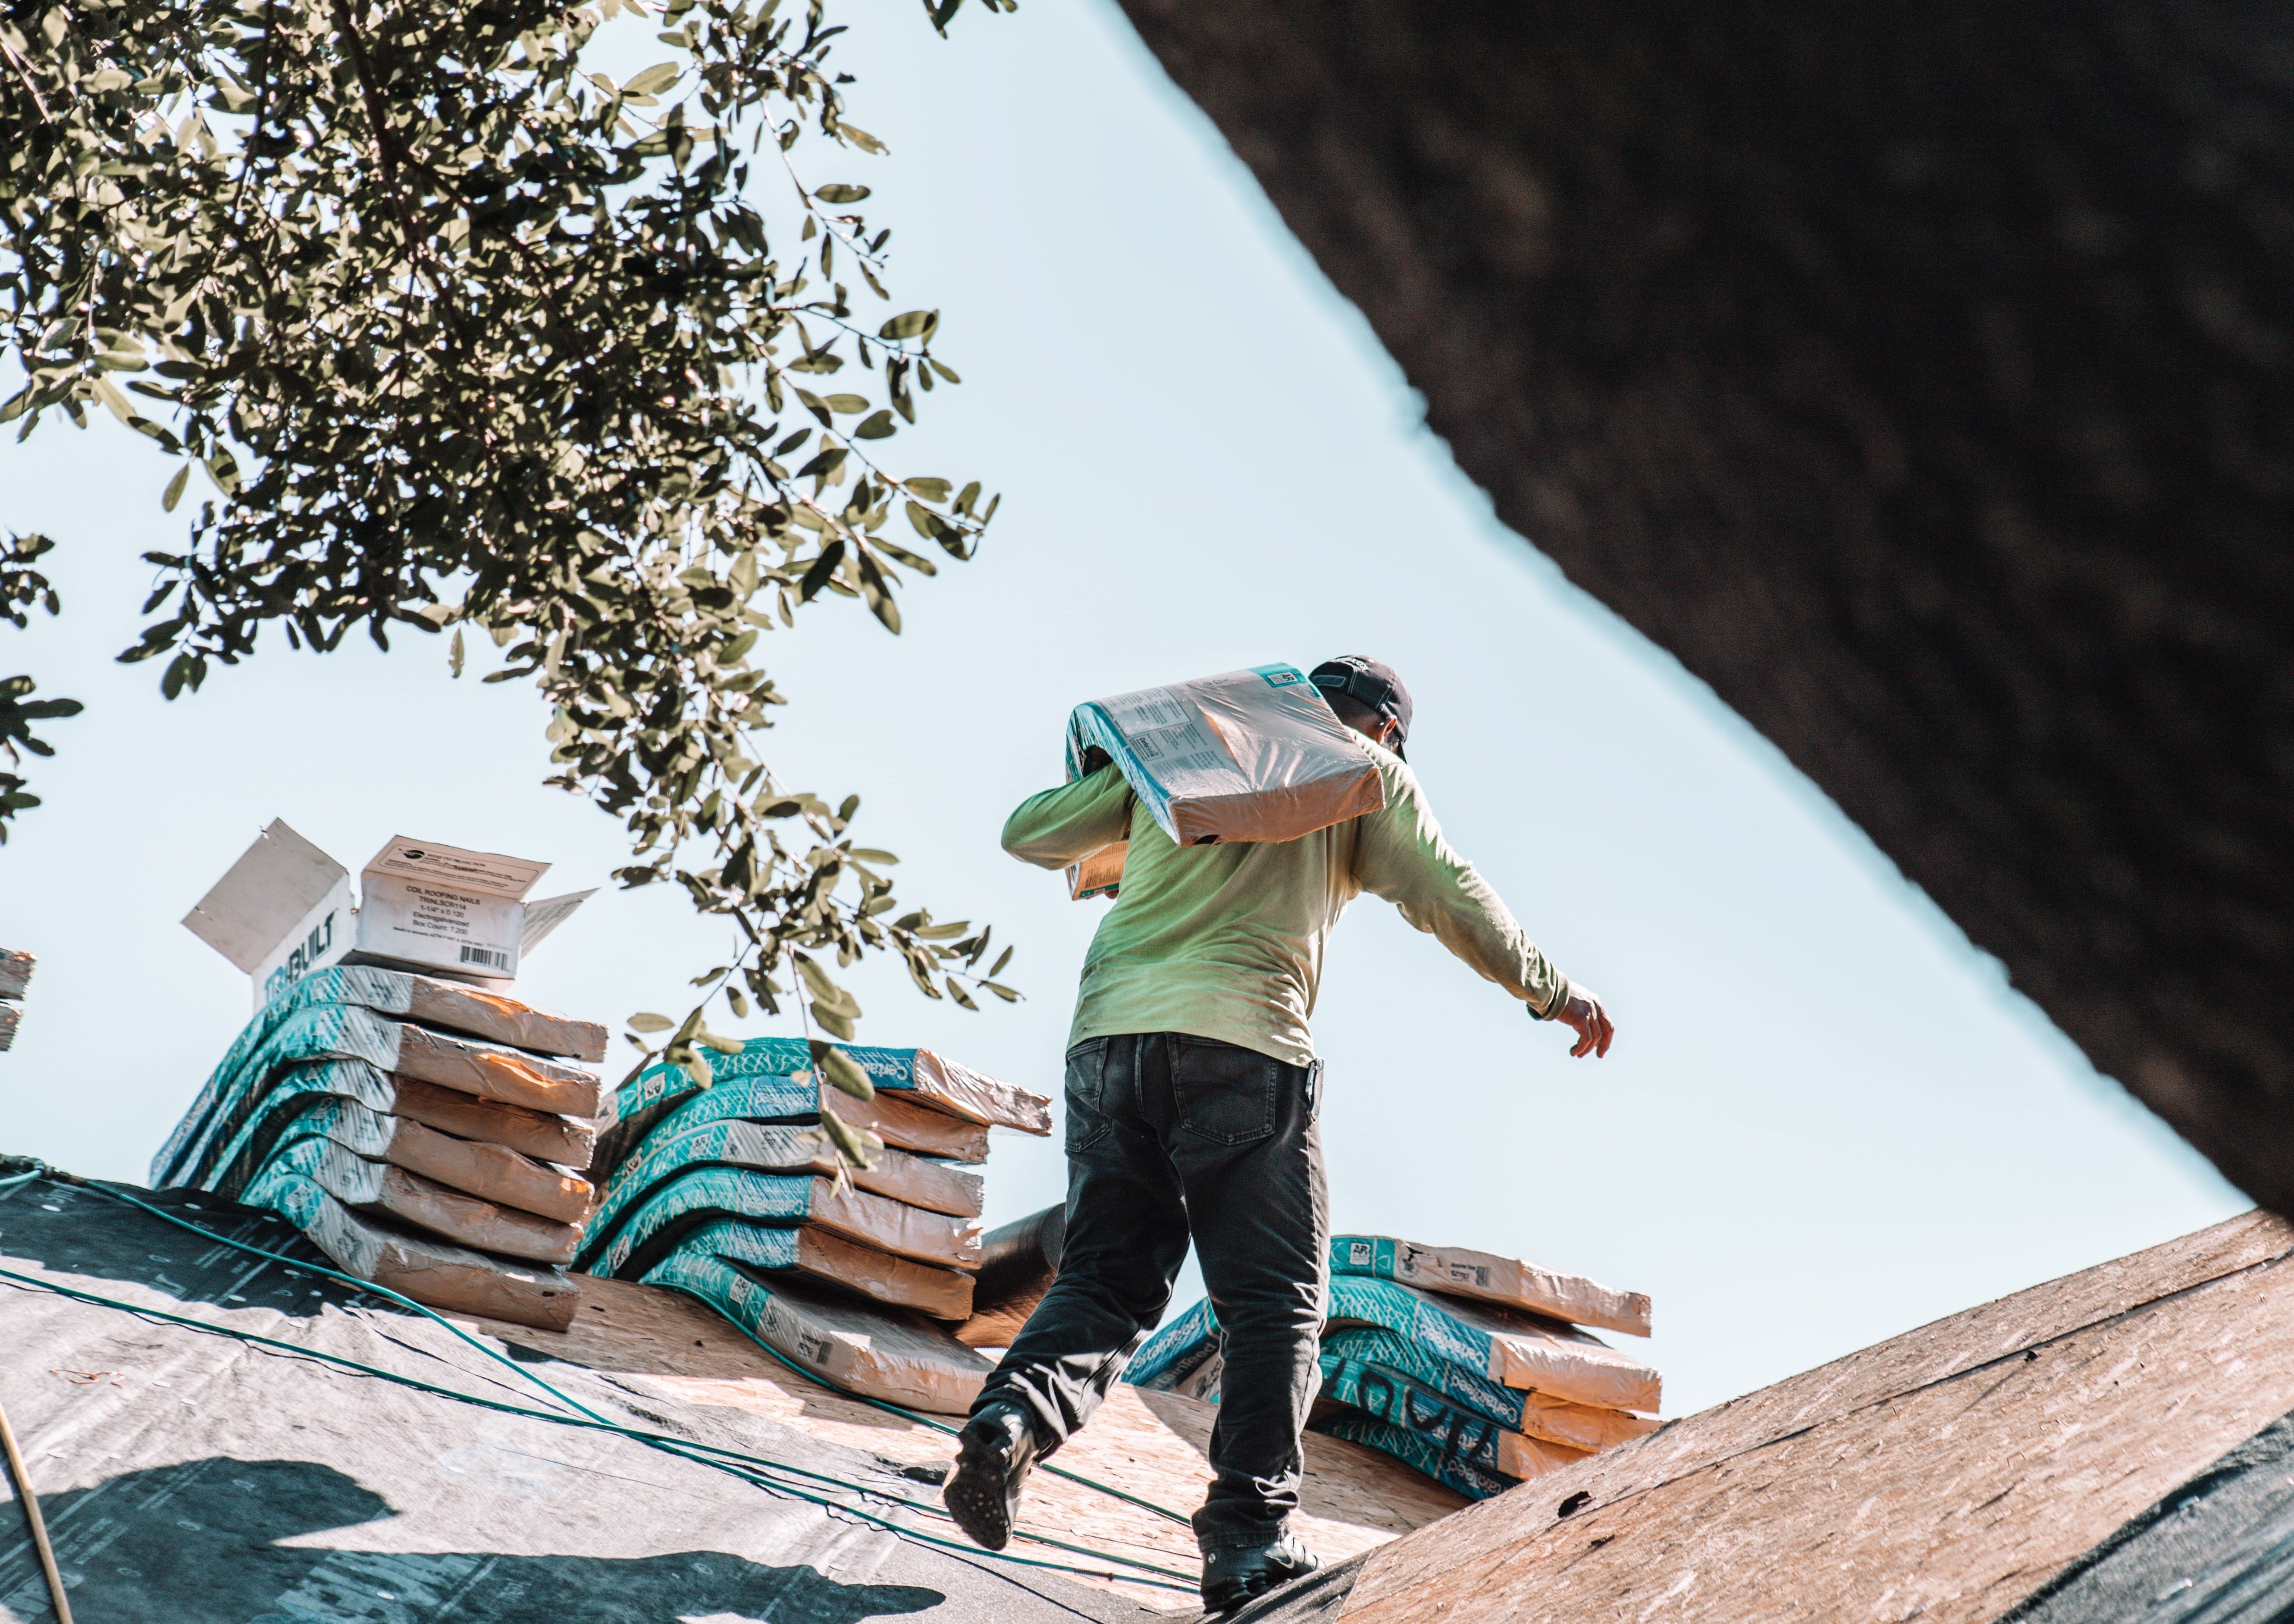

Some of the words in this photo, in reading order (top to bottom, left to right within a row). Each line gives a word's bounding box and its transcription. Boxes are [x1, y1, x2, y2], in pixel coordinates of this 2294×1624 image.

[407, 885, 422, 894] COIL
[425, 889, 458, 901] ROOFING
[459, 896, 480, 905] NAILS
[413, 911, 469, 927] Electrogalvanized
[446, 909, 464, 918] 0.120
[1124, 1313, 1200, 1375] CertainTeed
[1451, 1375, 1518, 1423] CertainTeed
